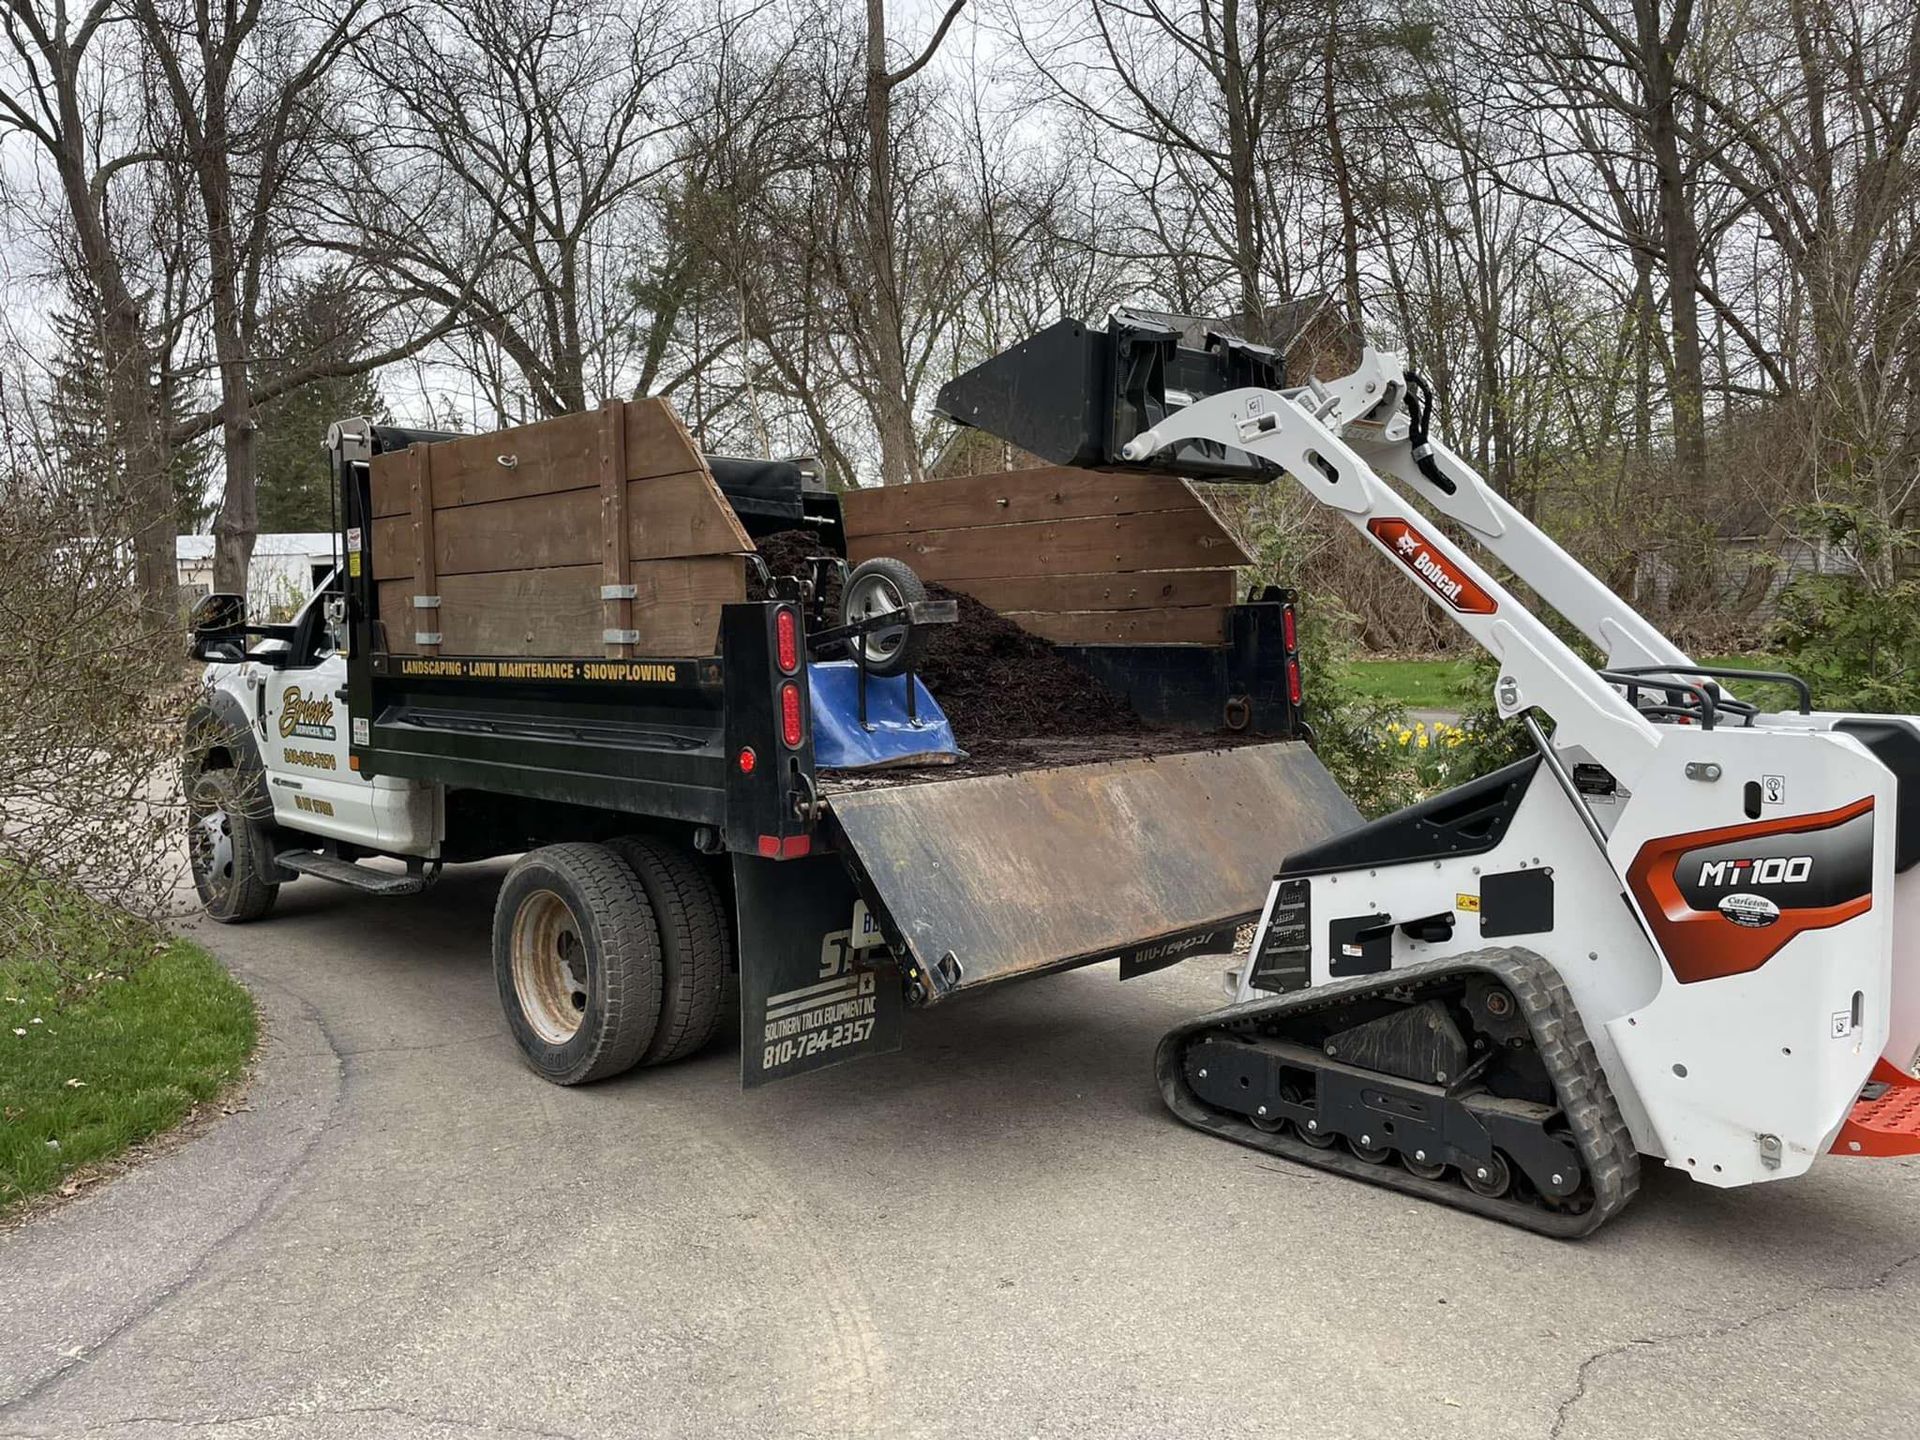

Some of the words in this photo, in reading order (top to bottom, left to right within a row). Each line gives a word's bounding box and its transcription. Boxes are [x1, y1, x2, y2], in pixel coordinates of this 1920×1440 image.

[1413, 551, 1463, 601] Bobcat
[402, 660, 461, 676] LANDSCAPING
[469, 661, 496, 677] LAWN
[499, 662, 574, 680] MAINTENANCE
[584, 664, 676, 682] SNOWPLOWING
[1698, 857, 1813, 887] MT100
[1727, 896, 1769, 908] Carleton
[764, 1017, 801, 1043] SOUTHERN
[802, 1007, 825, 1032] TRUCK
[824, 999, 864, 1026] EQUIPMENT
[863, 996, 877, 1014] INC
[763, 1017, 876, 1070] 810-724-2357
